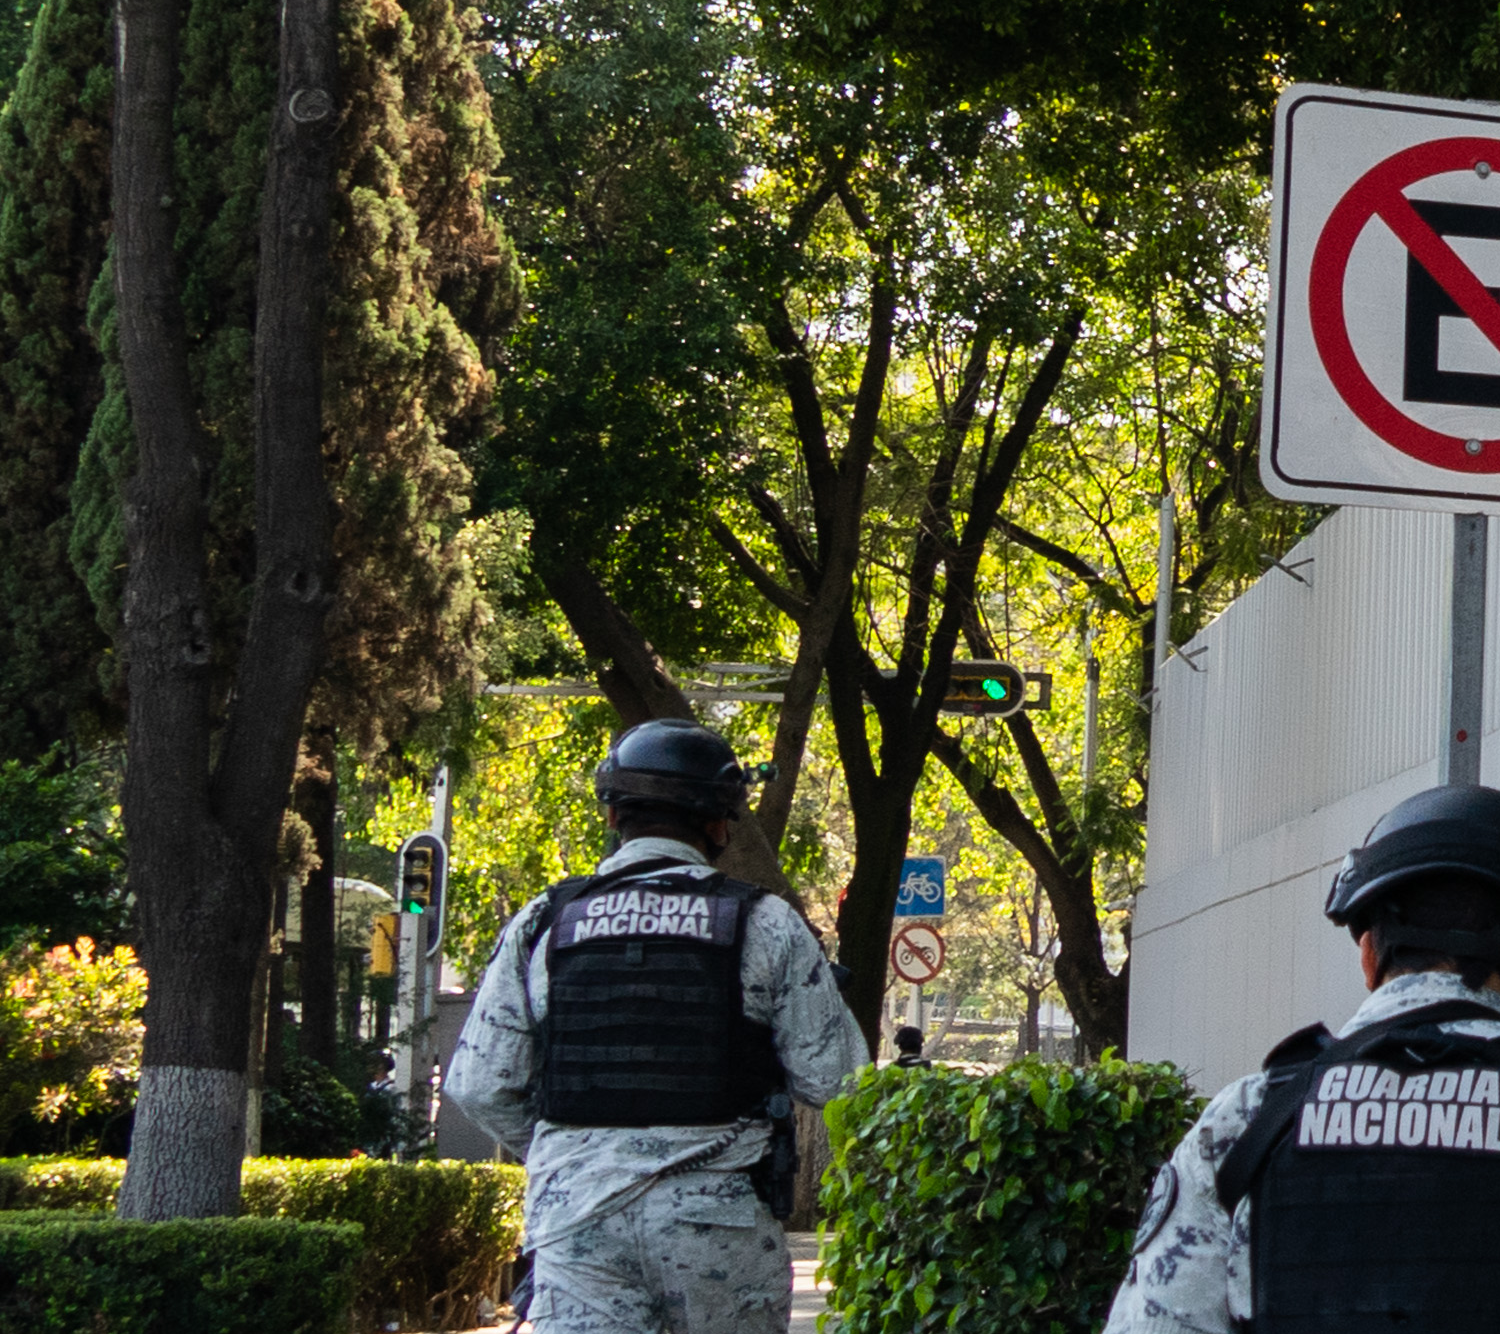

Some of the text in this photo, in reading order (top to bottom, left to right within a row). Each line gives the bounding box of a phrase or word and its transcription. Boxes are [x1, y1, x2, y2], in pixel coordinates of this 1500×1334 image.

[586, 890, 710, 917] GUARDIA
[573, 913, 713, 943] NACIONAL
[1317, 1064, 1500, 1106] GUARDIA
